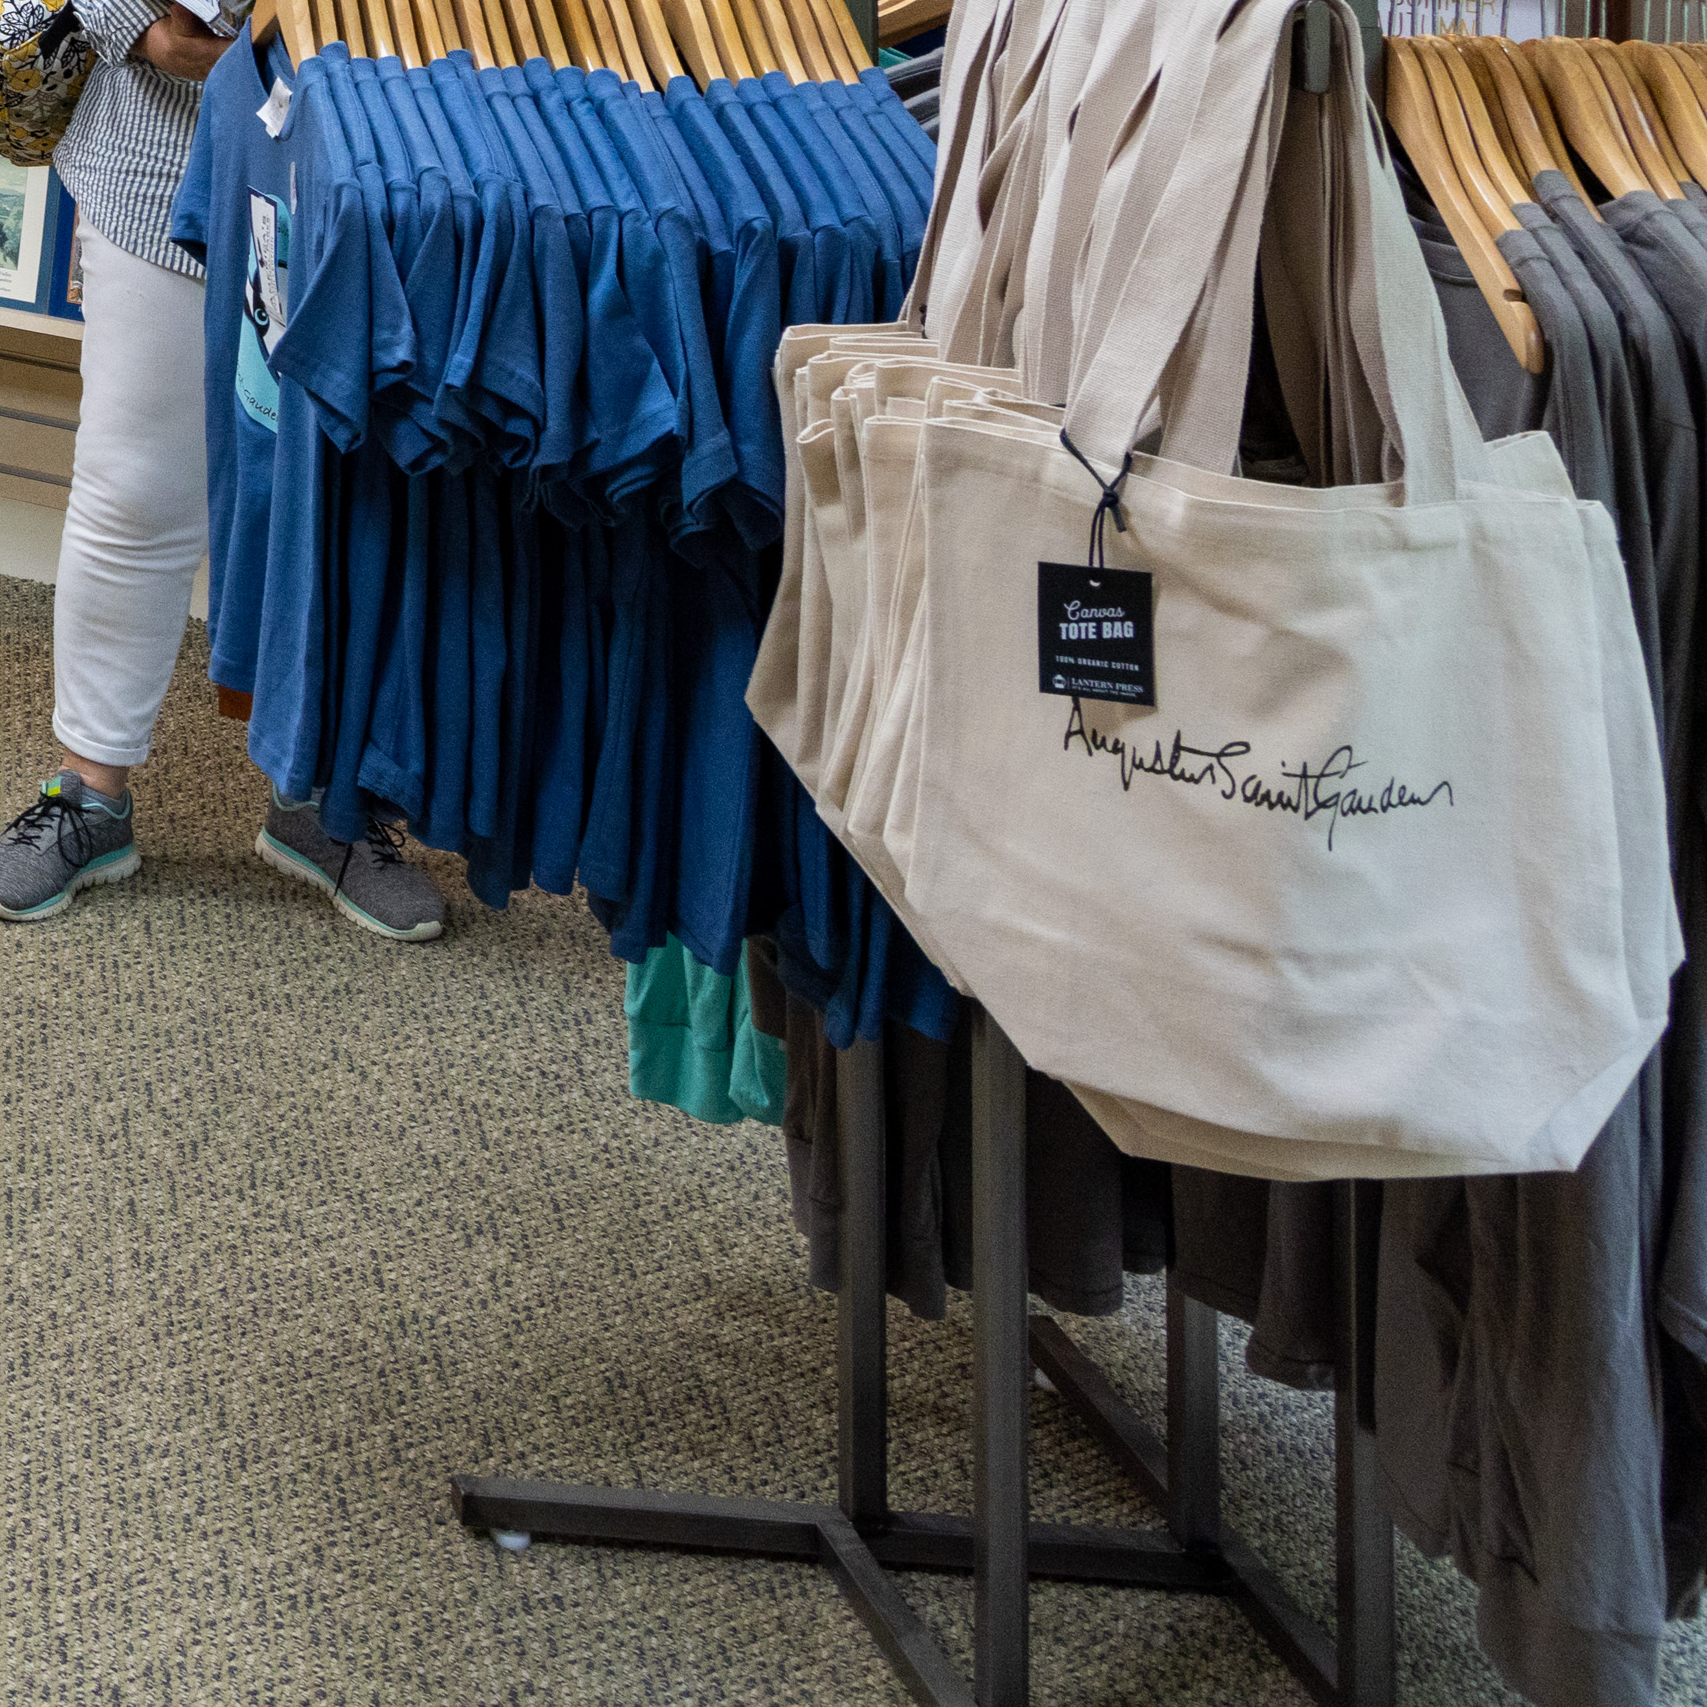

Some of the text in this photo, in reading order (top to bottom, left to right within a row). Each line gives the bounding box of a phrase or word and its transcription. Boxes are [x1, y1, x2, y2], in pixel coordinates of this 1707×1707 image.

[1063, 600, 1125, 621] Canvas
[1059, 621, 1134, 640] TOTE BAG
[1056, 655, 1139, 672] 100% ORGANIC COTTON
[1071, 678, 1143, 692] LANTERN PRESS
[1064, 696, 1216, 791] Augustus
[1304, 746, 1454, 852] Gaudens
